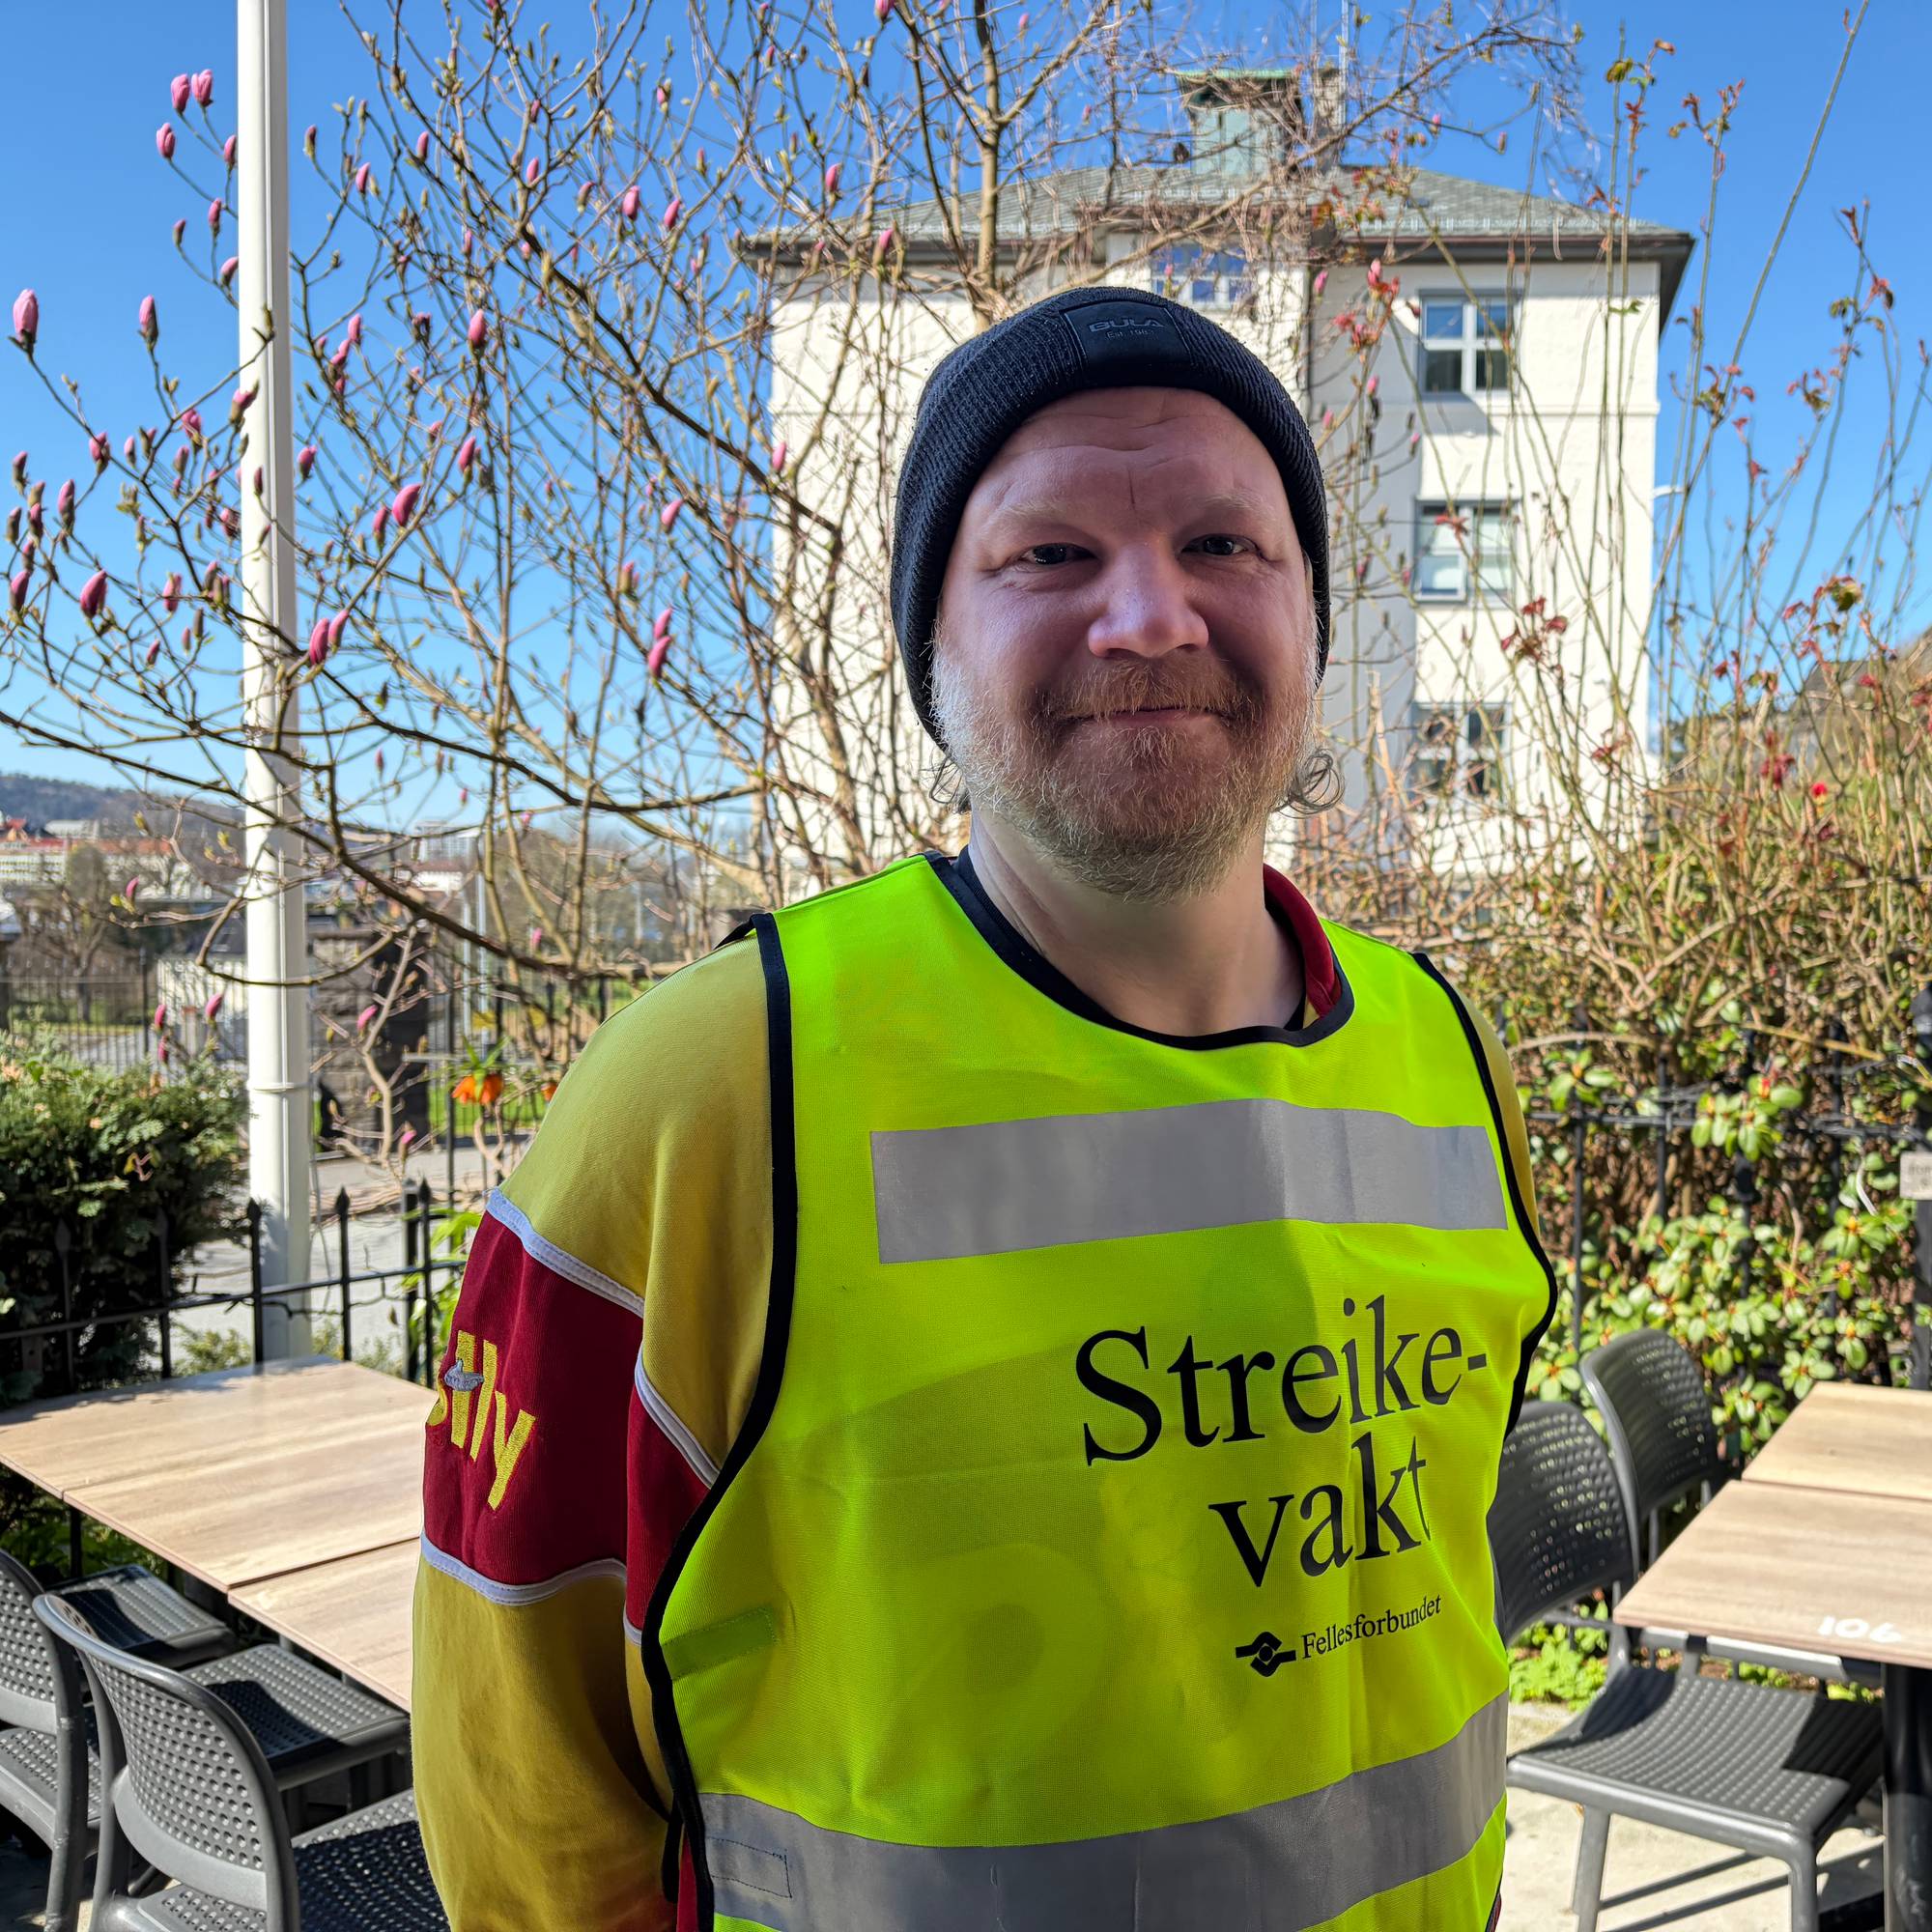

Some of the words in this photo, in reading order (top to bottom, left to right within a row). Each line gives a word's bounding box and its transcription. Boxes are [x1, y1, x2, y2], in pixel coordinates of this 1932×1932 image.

[1089, 318, 1164, 332] BULA
[1075, 1294, 1487, 1466] Streike-
[1208, 1431, 1432, 1588] vakt
[1301, 1593, 1442, 1659] Fellesforbundet
[1817, 1615, 1902, 1643] 106
